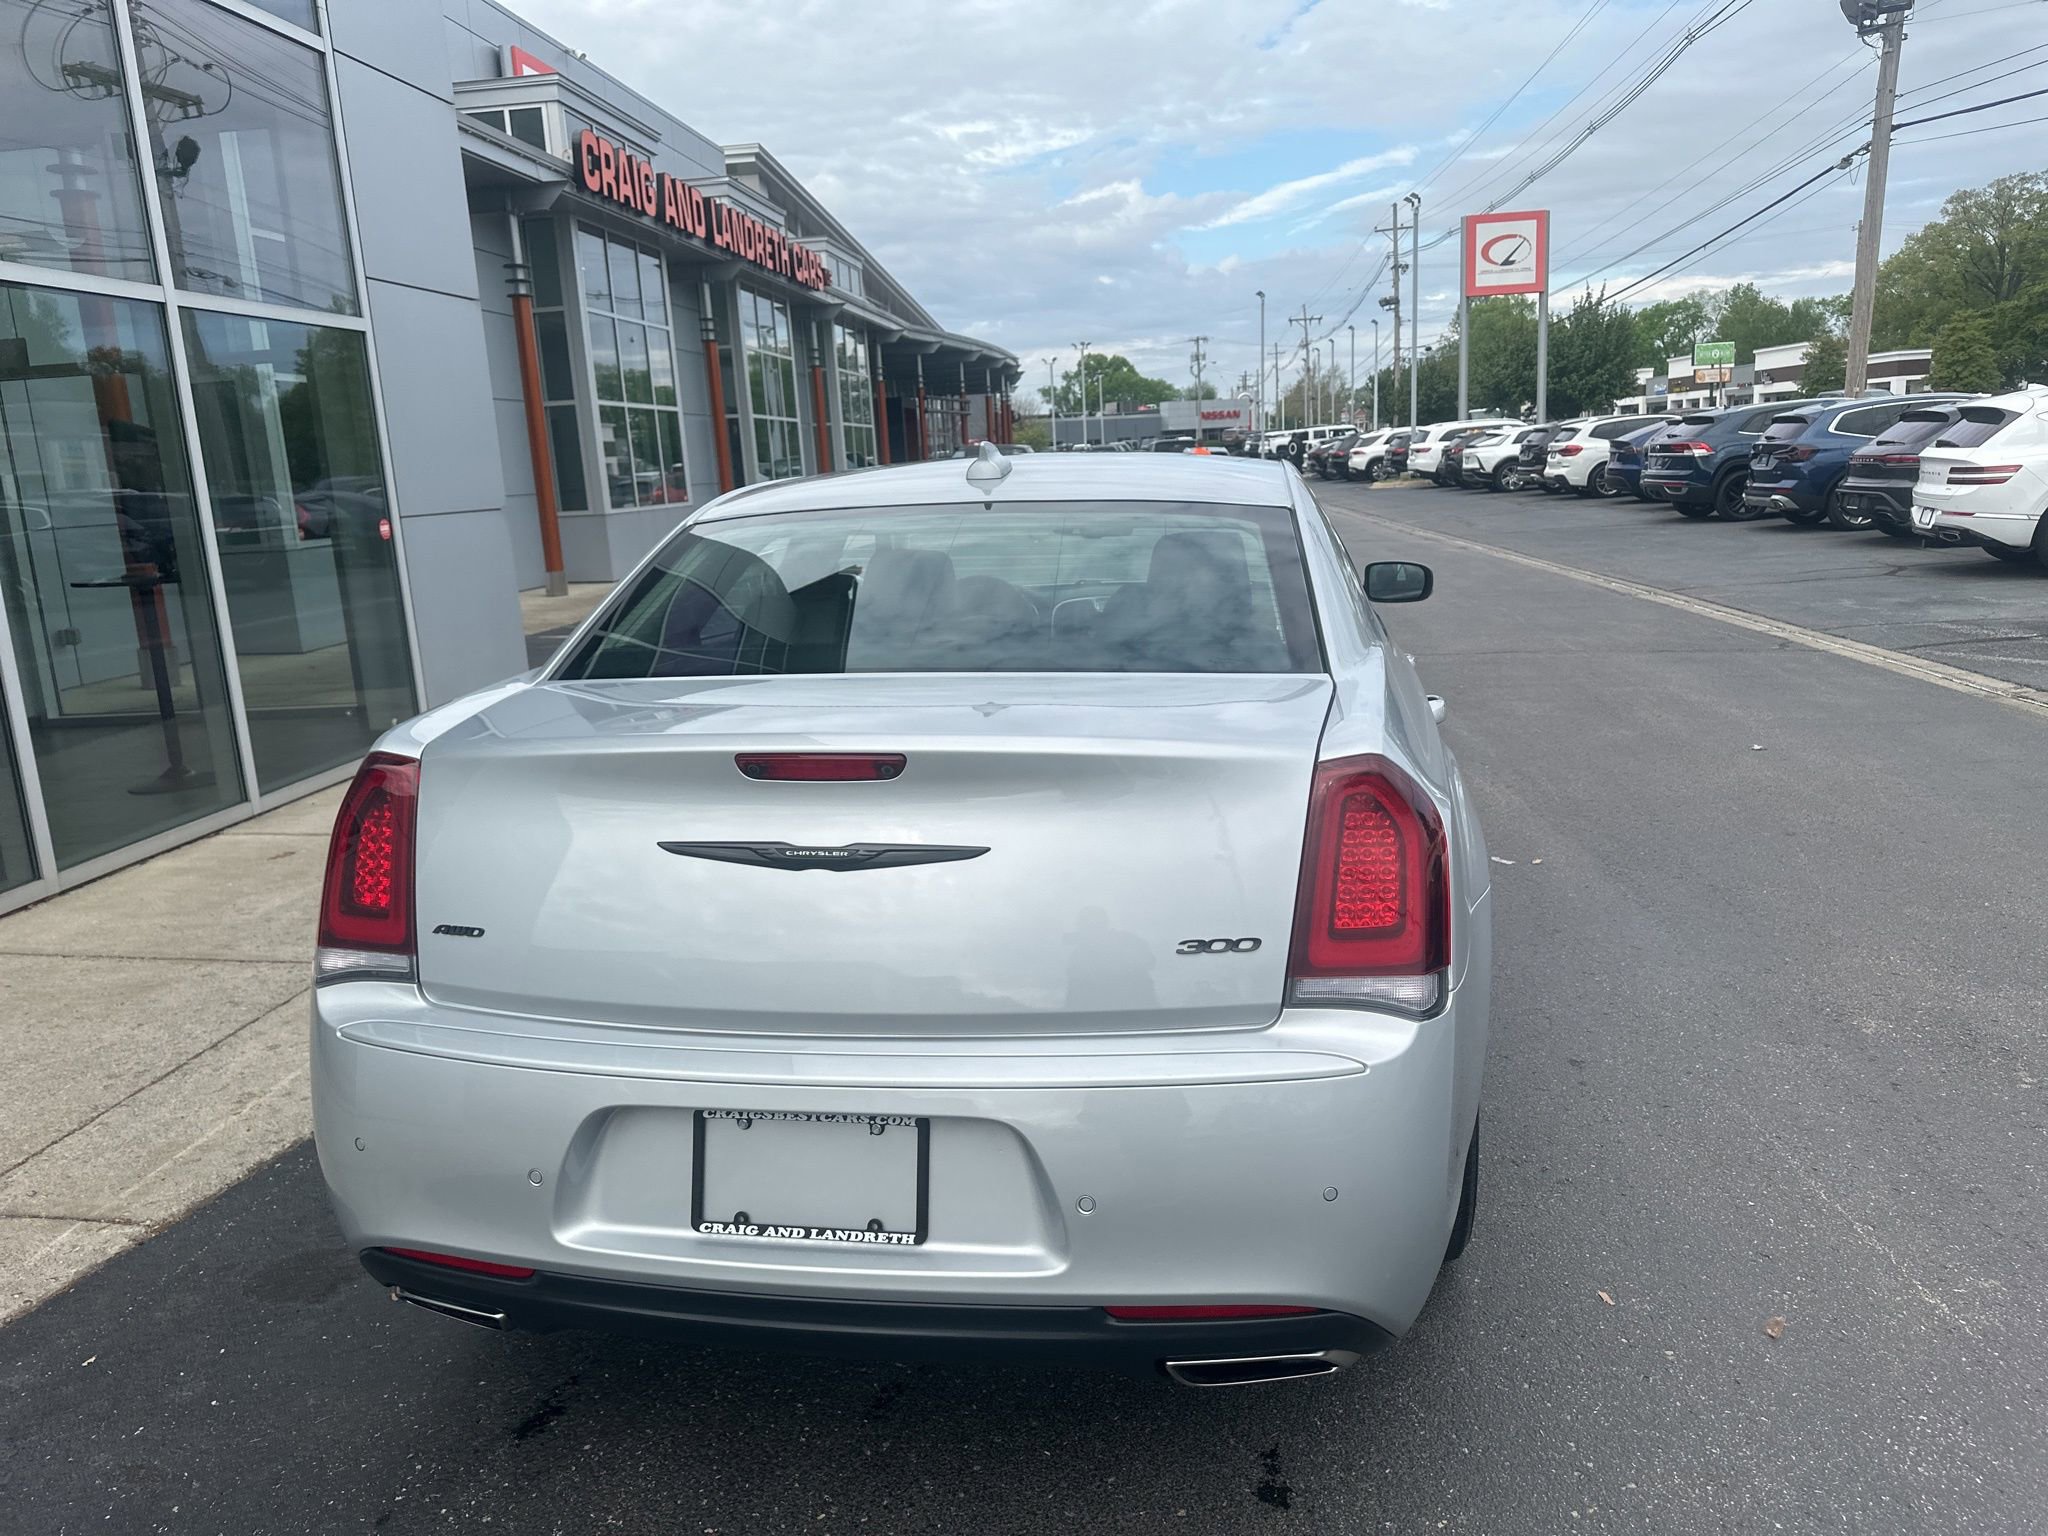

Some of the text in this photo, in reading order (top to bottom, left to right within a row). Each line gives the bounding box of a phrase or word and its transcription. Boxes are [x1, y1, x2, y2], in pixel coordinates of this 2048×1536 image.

[580, 128, 825, 292] CRAIG AND LANDRETH CARS
[1200, 410, 1241, 420] NISSAN
[431, 924, 486, 938] AWD
[1175, 937, 1263, 955] 300
[698, 1222, 916, 1245] CRAIG AND LANDRETH
